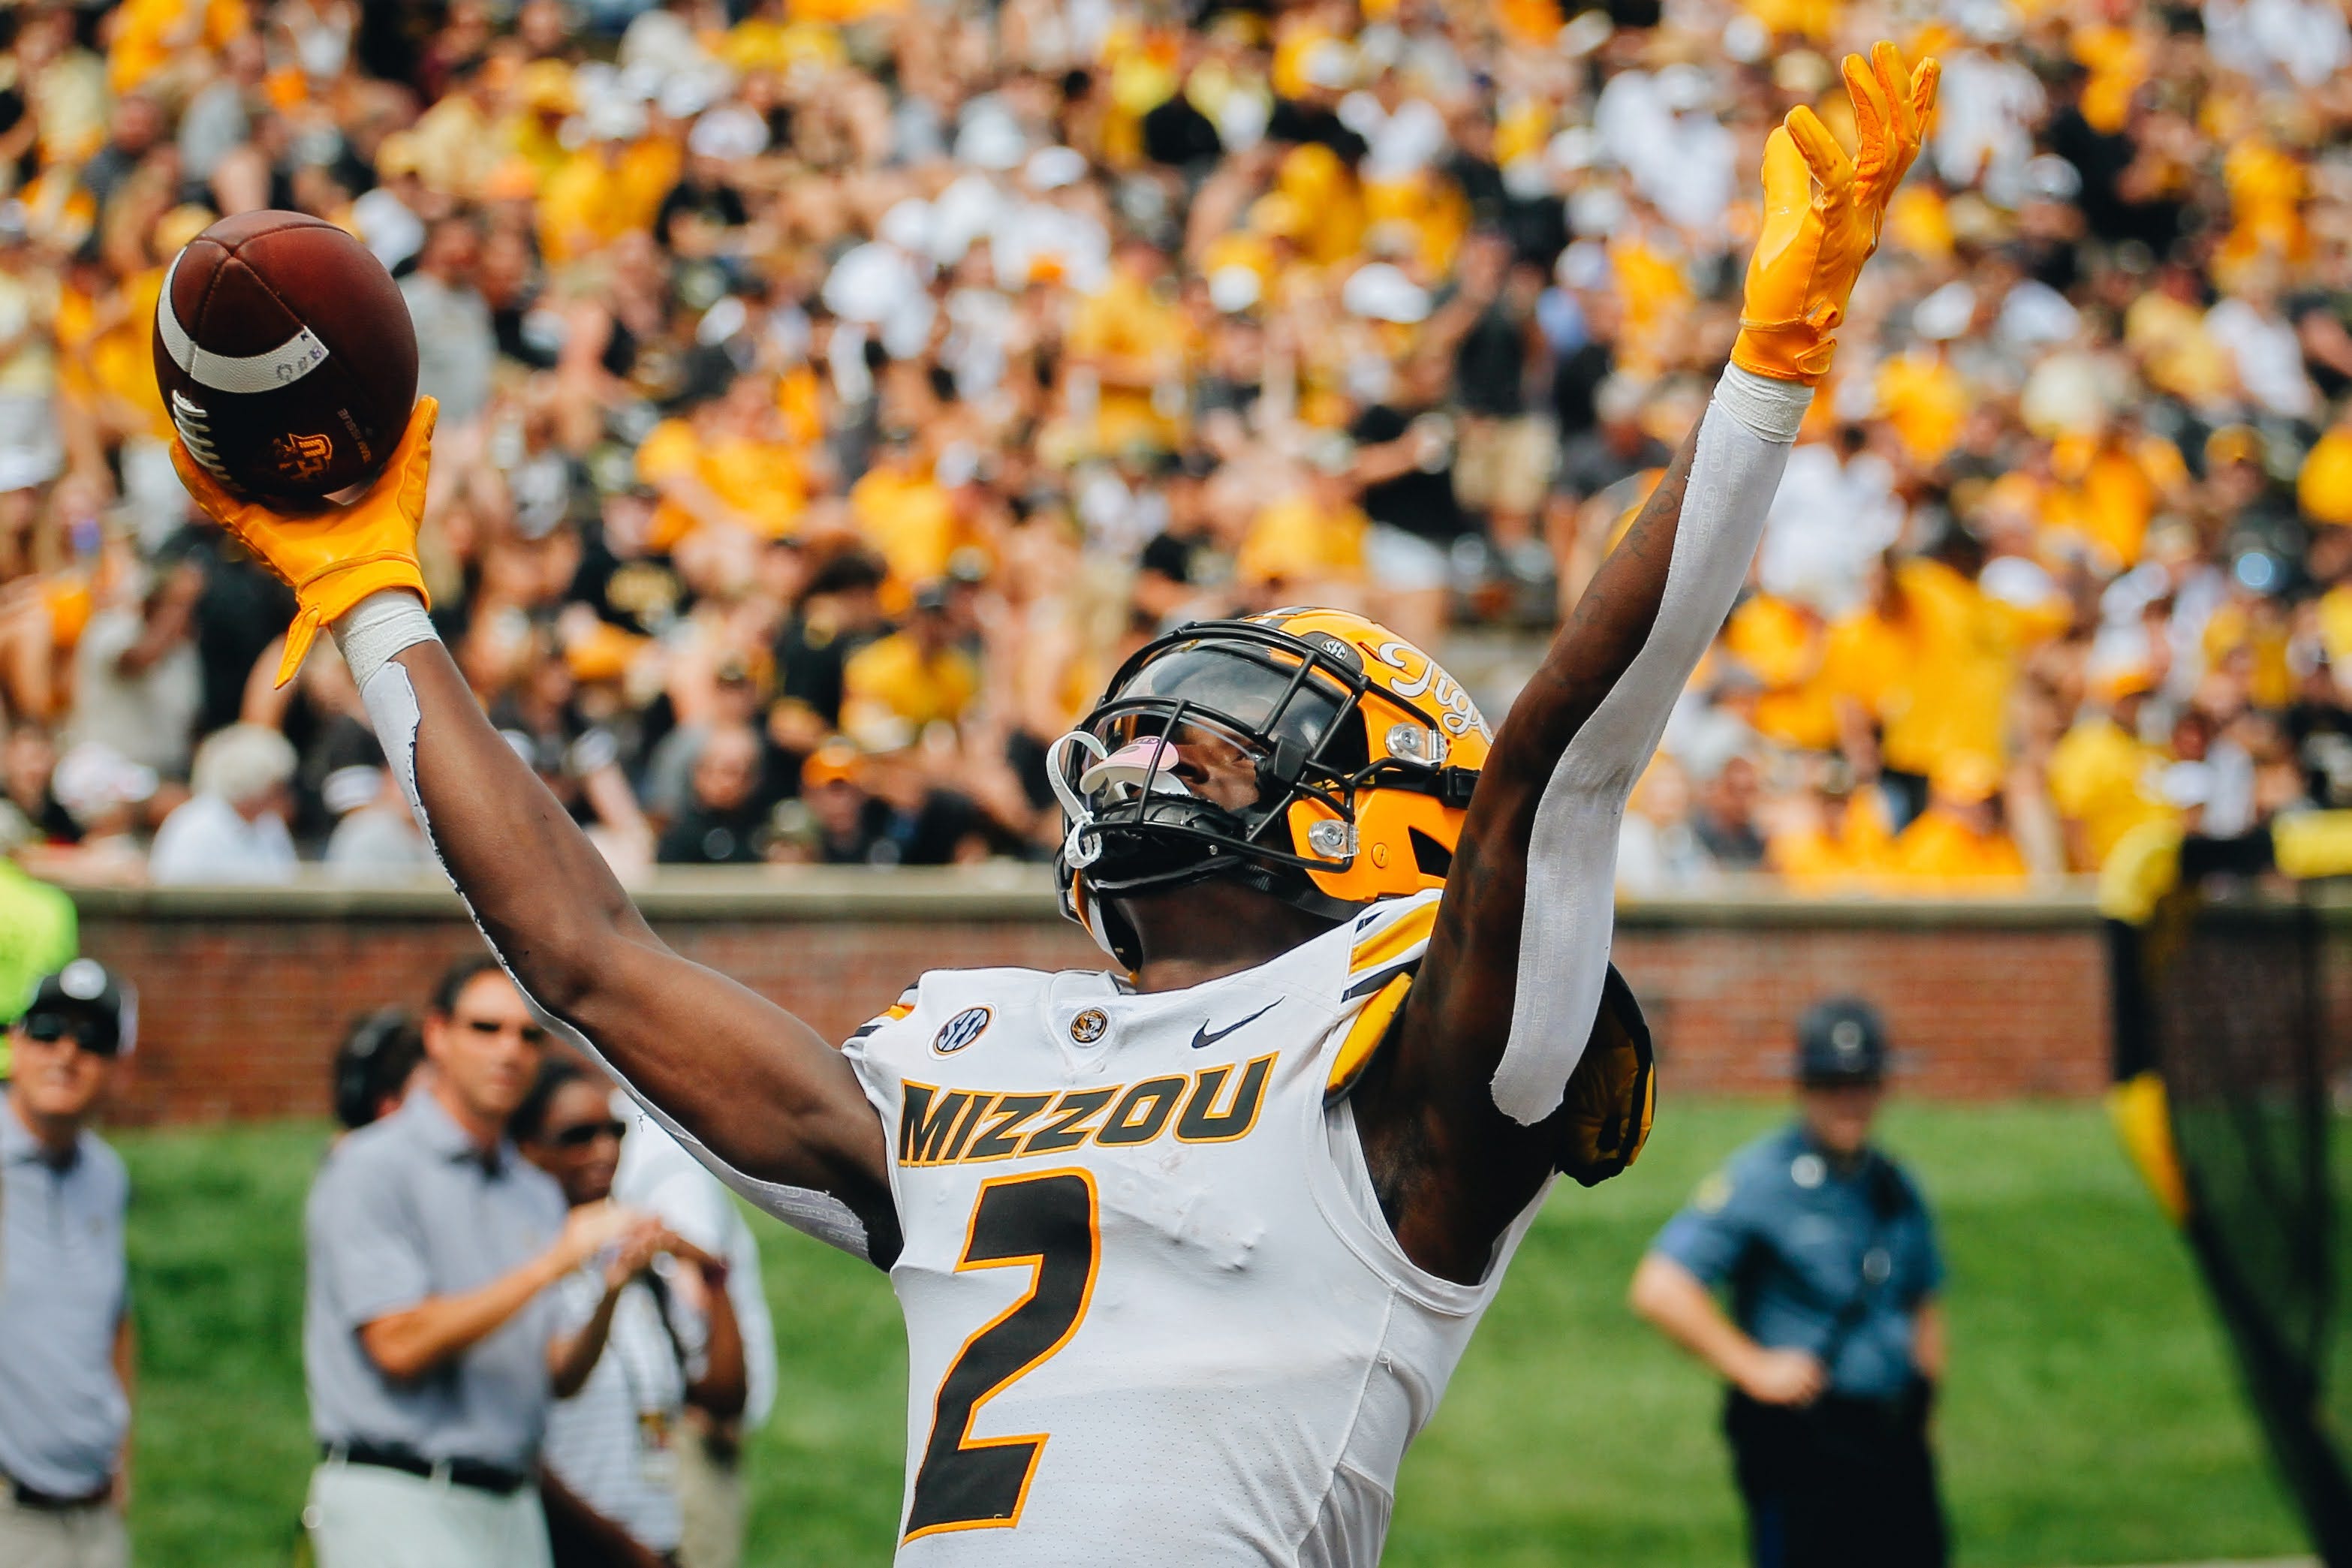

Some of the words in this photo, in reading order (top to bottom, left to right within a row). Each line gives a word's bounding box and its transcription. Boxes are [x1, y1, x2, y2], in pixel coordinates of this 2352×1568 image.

[1322, 640, 1347, 661] SEC
[938, 1007, 989, 1052] SEC
[899, 1051, 1279, 1167] MIZZOU
[901, 1167, 1101, 1547] 2
